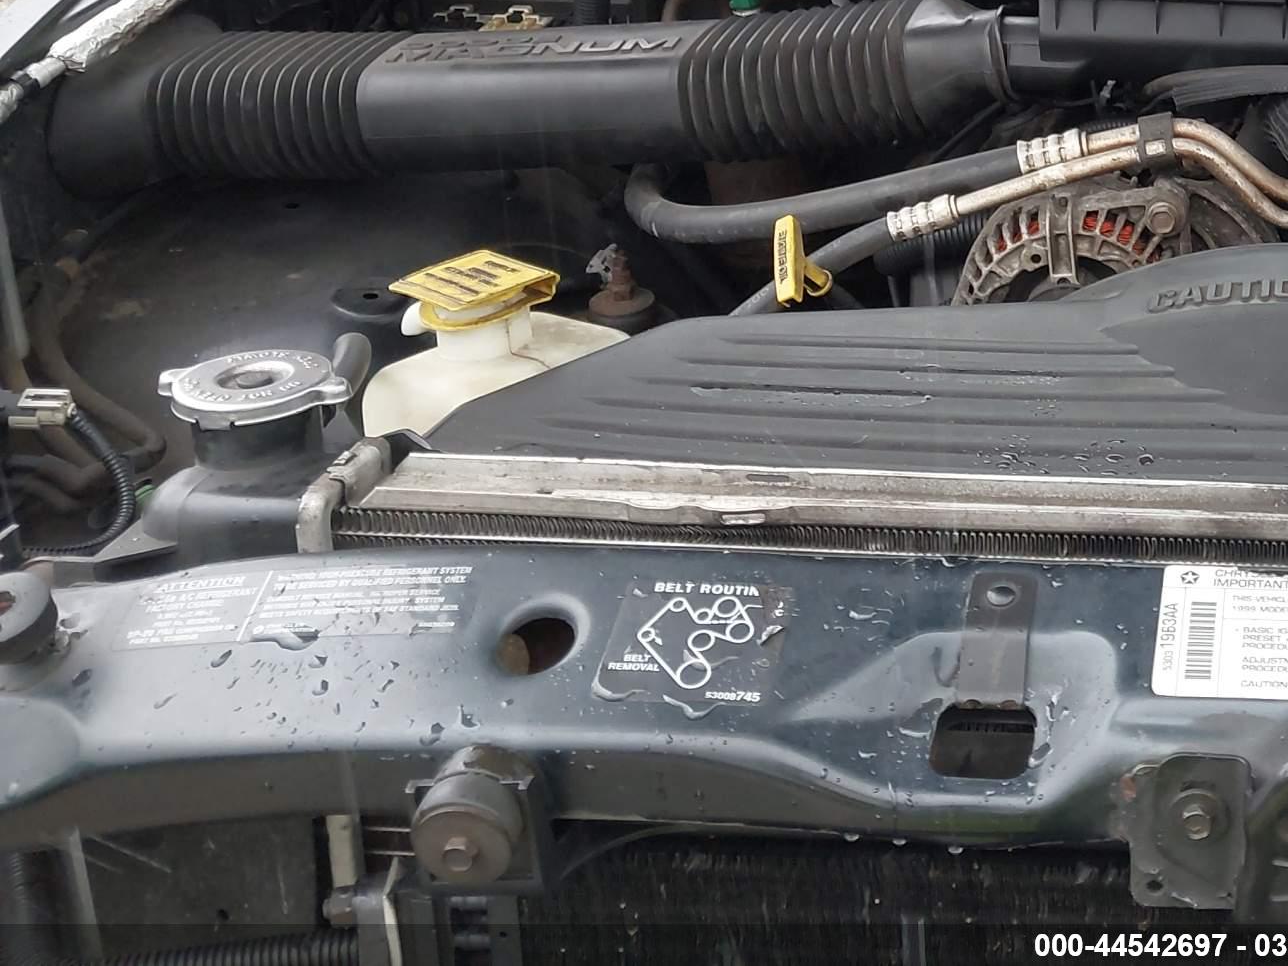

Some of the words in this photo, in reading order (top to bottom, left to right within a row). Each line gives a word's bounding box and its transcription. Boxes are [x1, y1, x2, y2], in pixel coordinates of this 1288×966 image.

[385, 37, 682, 63] MAGNUM
[439, 566, 473, 575] SYSTEM
[654, 582, 696, 594] BELT
[414, 596, 445, 604] SYSTEM
[1243, 626, 1274, 634] BASIC
[623, 653, 651, 662] BELT
[607, 662, 660, 672] REMOVAL
[704, 691, 762, 703] 53008745
